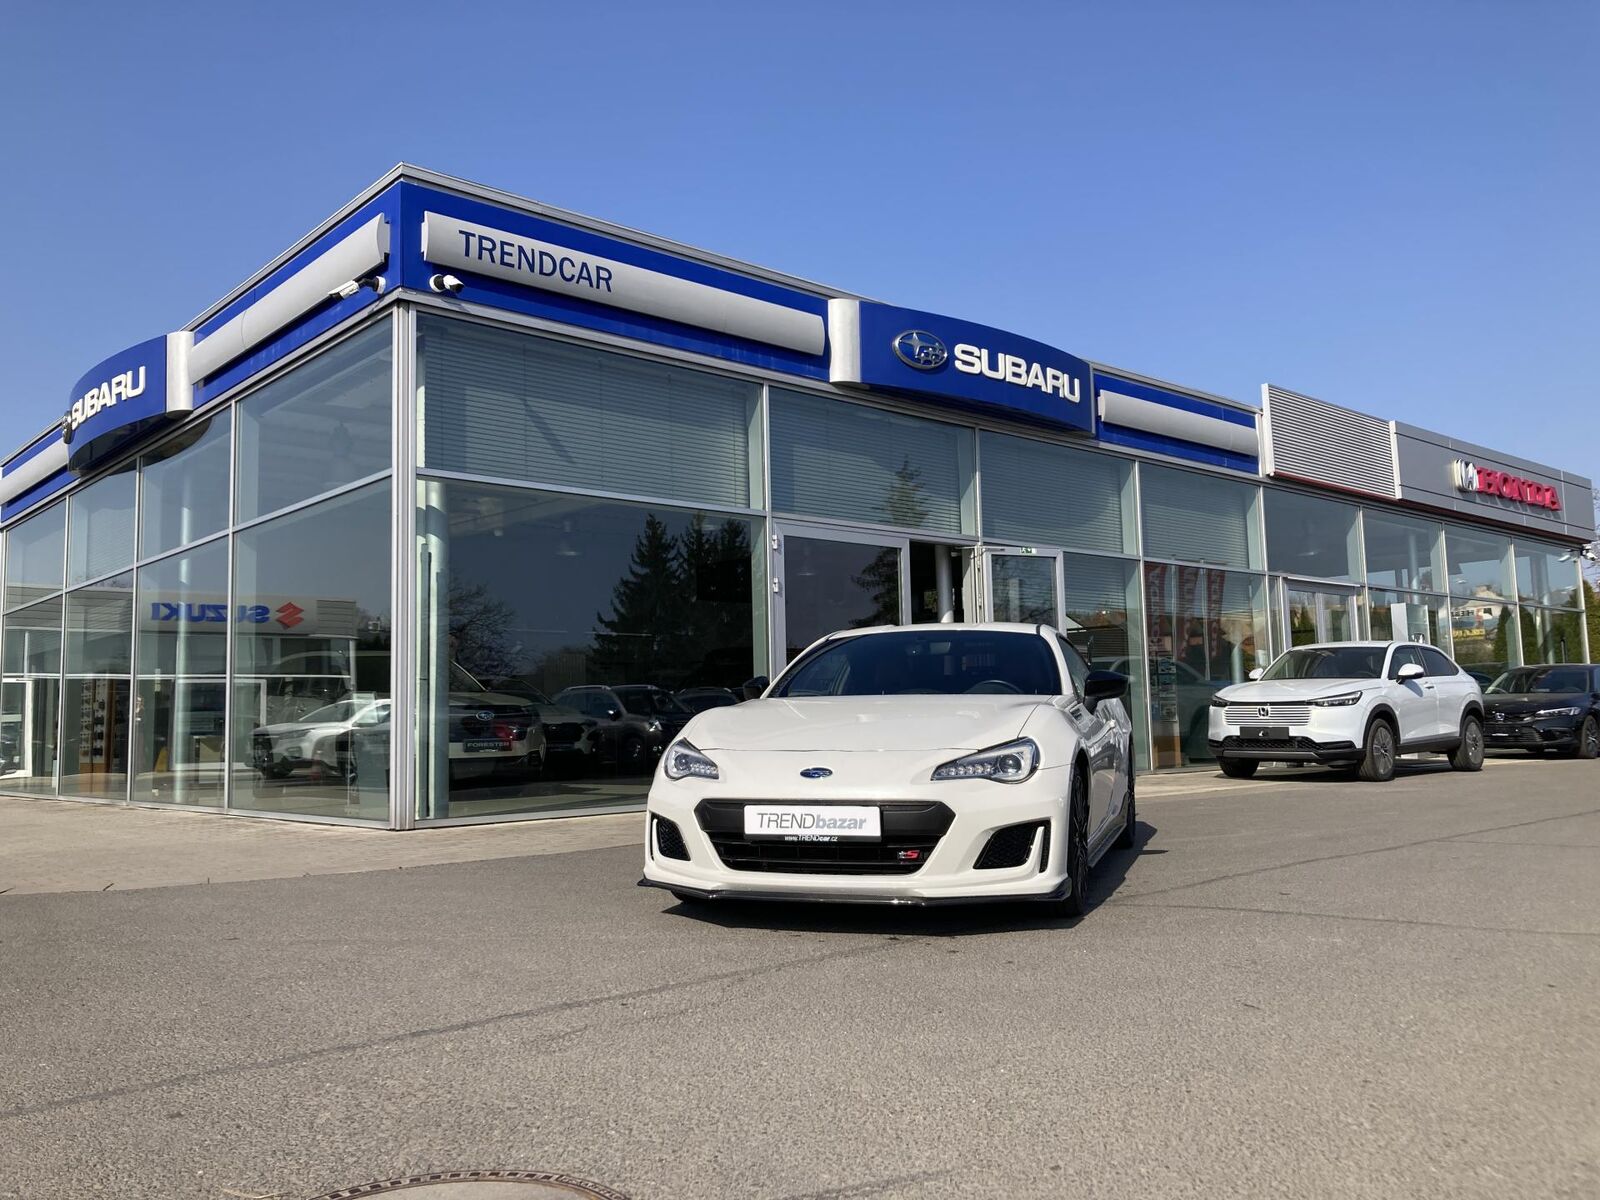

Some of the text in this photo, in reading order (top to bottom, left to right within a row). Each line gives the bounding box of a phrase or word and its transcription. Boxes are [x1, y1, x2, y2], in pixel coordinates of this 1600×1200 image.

[458, 229, 613, 293] TRENDCAR
[71, 365, 146, 431] SUBARU
[953, 343, 1080, 403] SUBARU
[1475, 465, 1562, 511] HONDA
[757, 812, 867, 830] TRENDbazar
